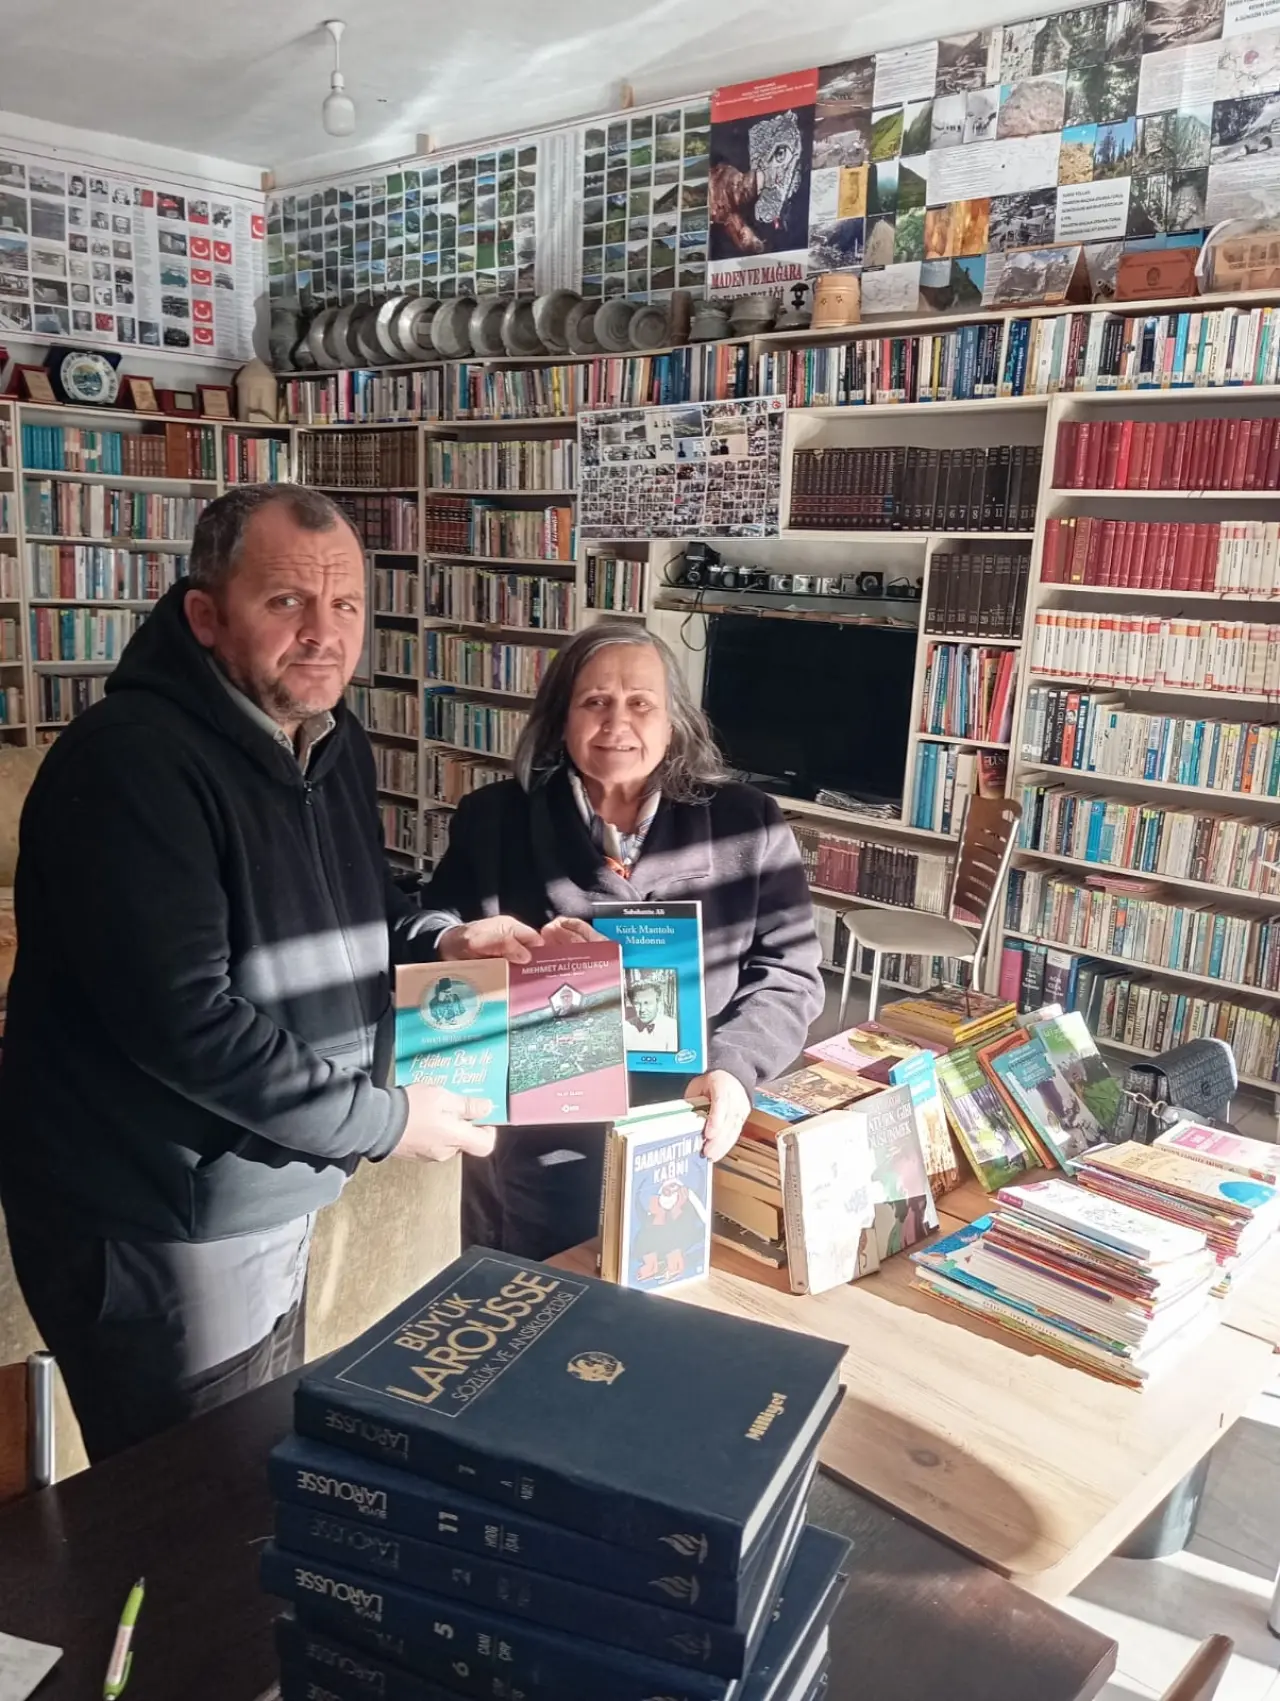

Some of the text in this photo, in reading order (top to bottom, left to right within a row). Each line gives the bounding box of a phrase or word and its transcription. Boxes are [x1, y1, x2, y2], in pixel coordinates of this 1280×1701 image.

[710, 261, 803, 290] MADEN VE MAĞARA
[615, 924, 675, 935] Kürk Mantolu
[625, 935, 666, 945] Madonna
[521, 964, 557, 975] MEHMET
[634, 1136, 692, 1172] SABAHATTİN
[386, 1271, 560, 1404] LAROUSSE
[394, 1292, 481, 1352] BÜYÜK
[451, 1290, 575, 1402] SÖZLÜK VE ANSİKLOPEDİSİ
[744, 1392, 788, 1441] Milliyet
[296, 1469, 388, 1510] LAROUSSE
[437, 1510, 459, 1534] 11
[294, 1567, 383, 1614] LAROUSSE
[433, 1621, 454, 1640] 5
[451, 1660, 470, 1678] 6
